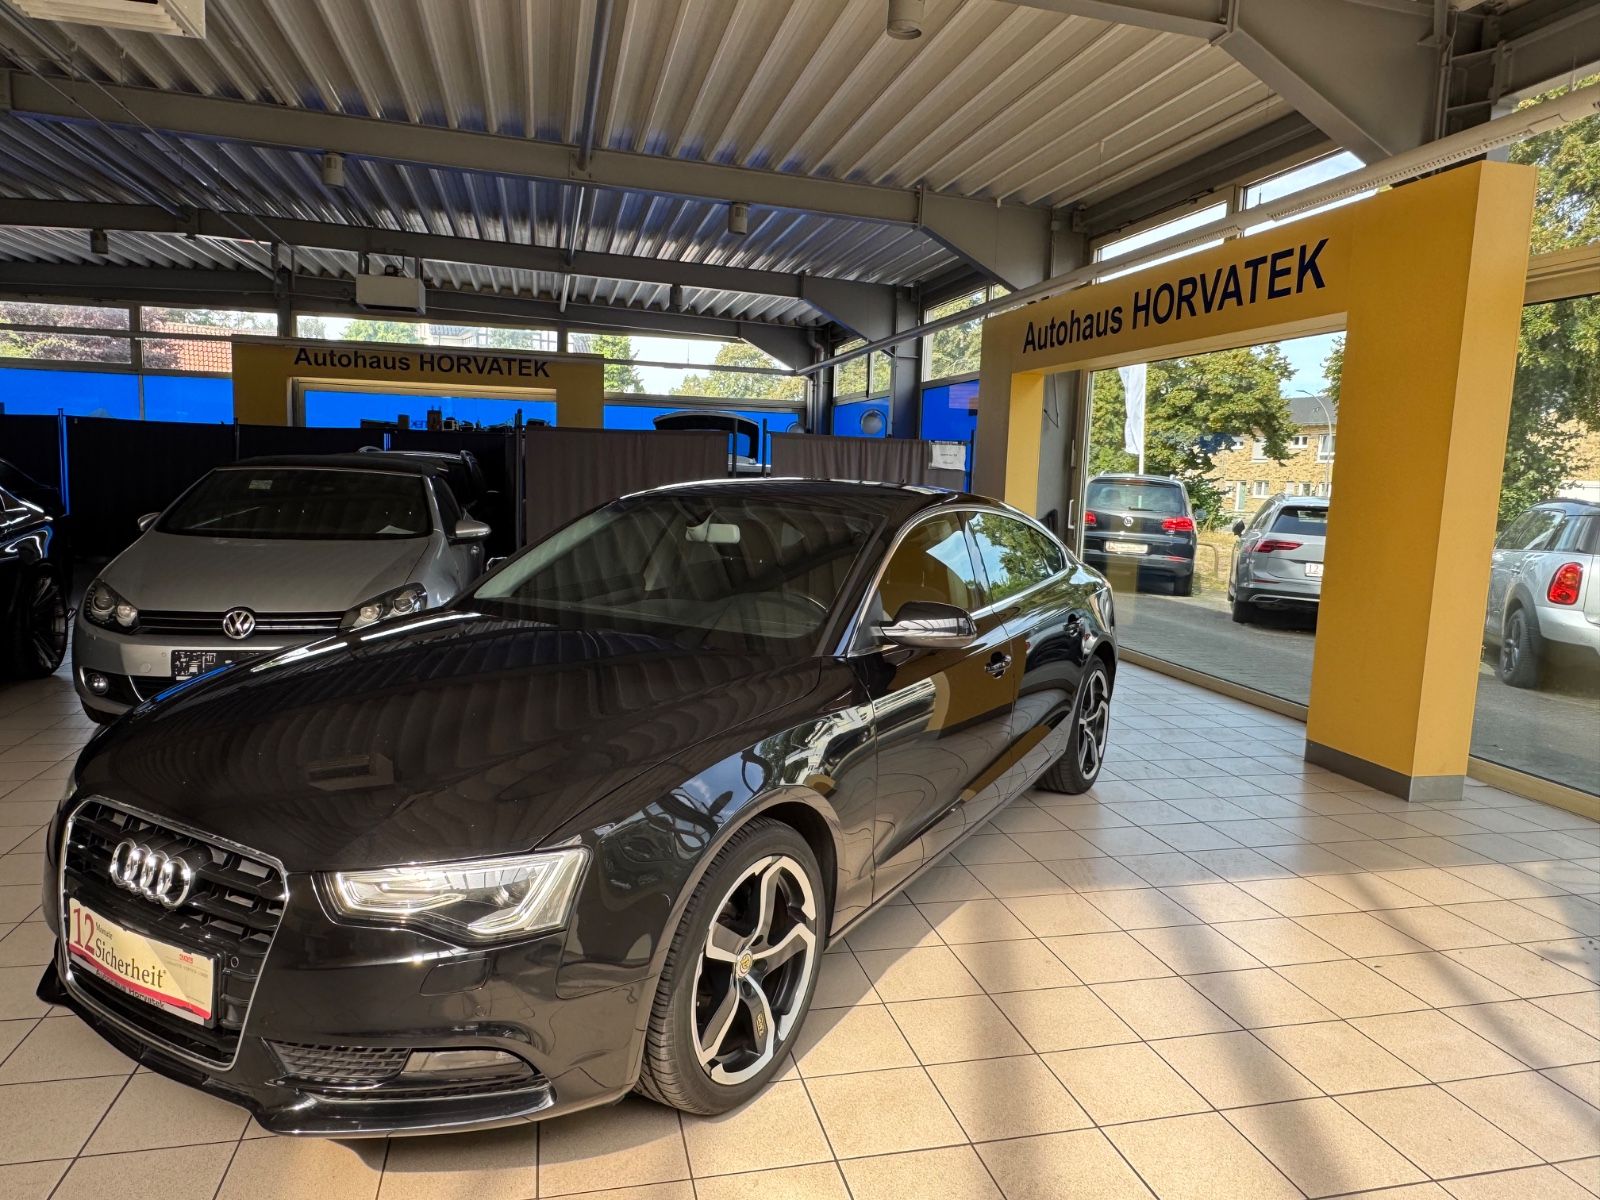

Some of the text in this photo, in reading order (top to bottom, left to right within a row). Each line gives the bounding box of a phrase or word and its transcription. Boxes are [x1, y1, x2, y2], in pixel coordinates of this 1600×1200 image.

[1023, 239, 1329, 354] Autohaus HORVATEK
[294, 347, 550, 378] Autohaus HORVATEK
[73, 907, 96, 956] 12
